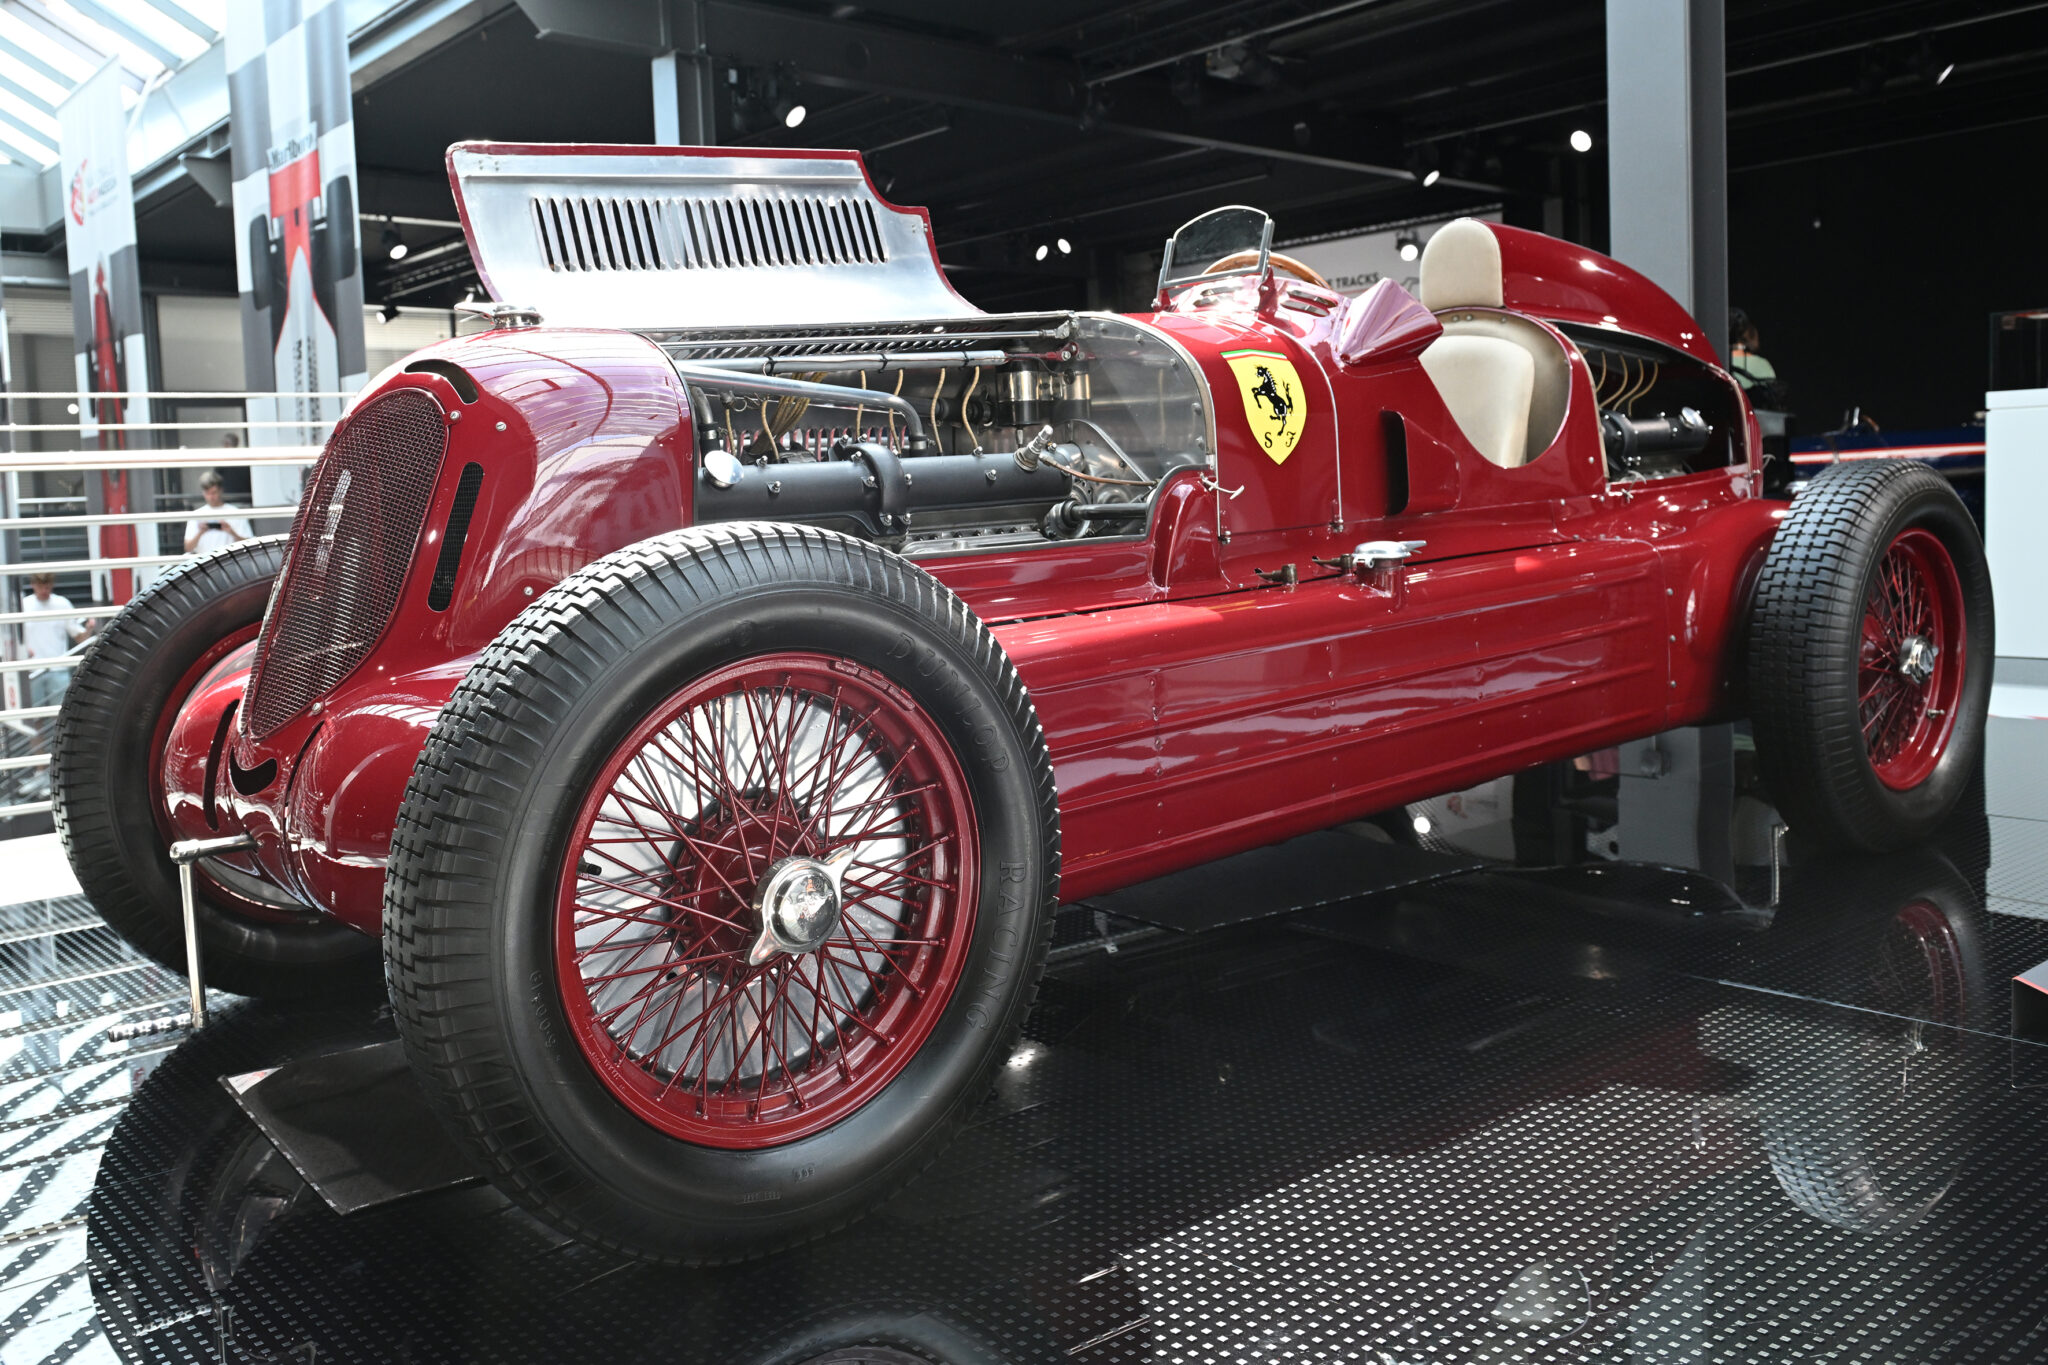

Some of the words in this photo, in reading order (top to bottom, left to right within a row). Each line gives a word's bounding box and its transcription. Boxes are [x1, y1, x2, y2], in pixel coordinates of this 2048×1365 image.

[1336, 272, 1378, 288] TRACKS
[1264, 431, 1273, 448] S
[1285, 431, 1296, 447] F
[886, 632, 1009, 772] DUNLOP
[966, 862, 1026, 1030] RACING
